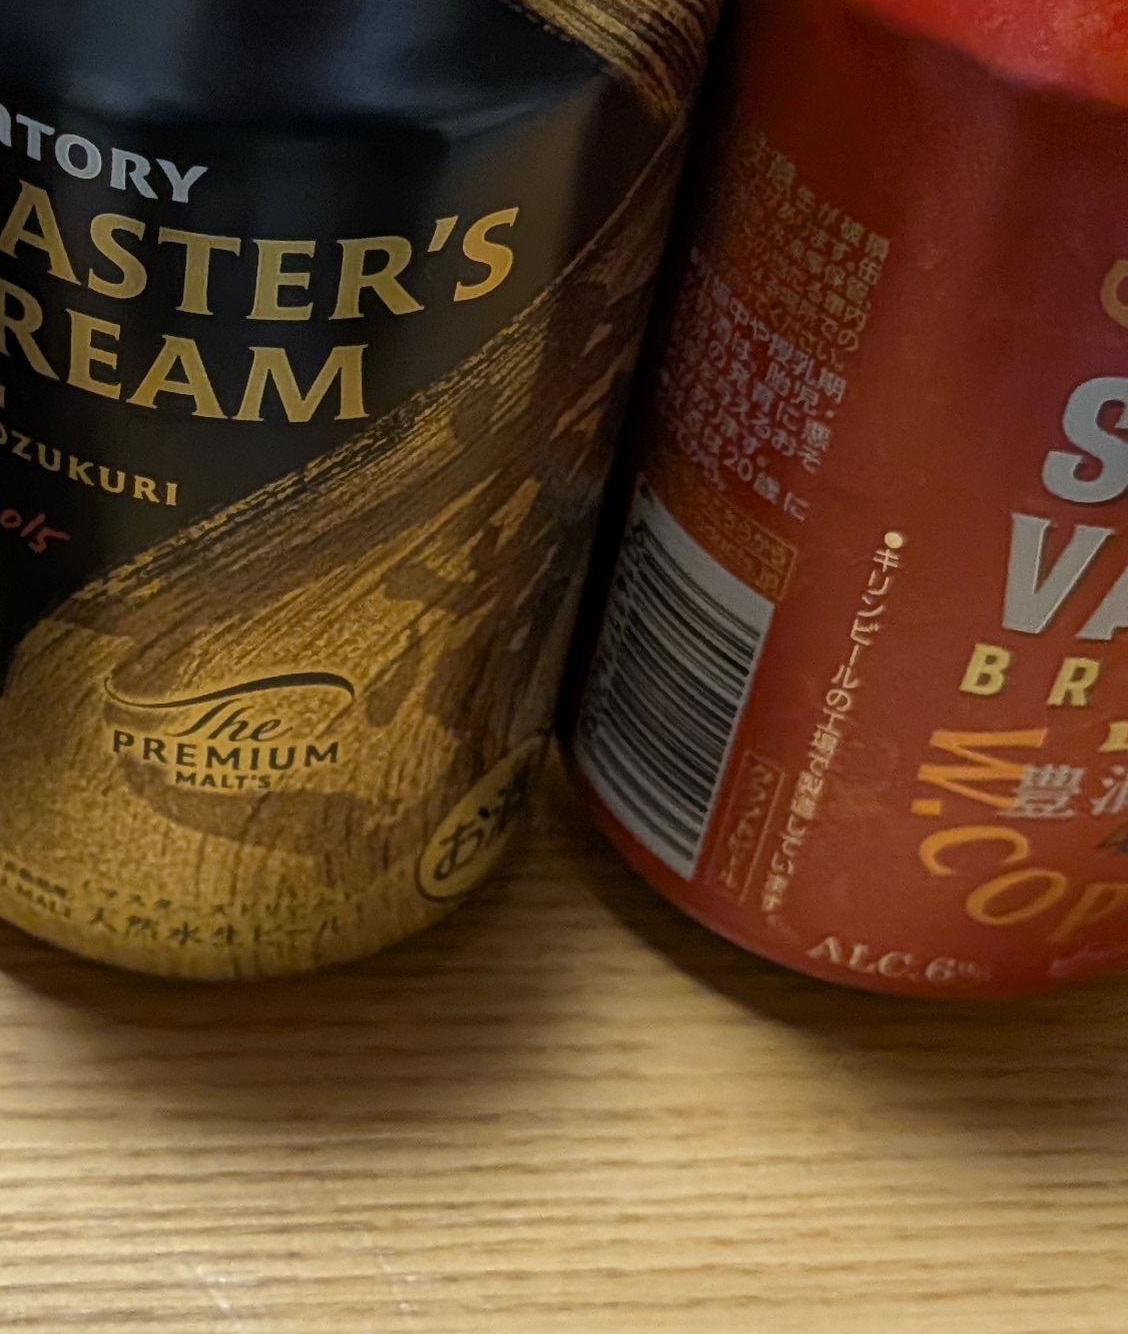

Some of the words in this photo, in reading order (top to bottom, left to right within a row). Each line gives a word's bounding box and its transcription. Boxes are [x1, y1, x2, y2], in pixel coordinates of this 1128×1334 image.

[170, 699, 293, 742] The
[112, 728, 341, 771] PREMIUM
[174, 769, 272, 791] MALT'S
